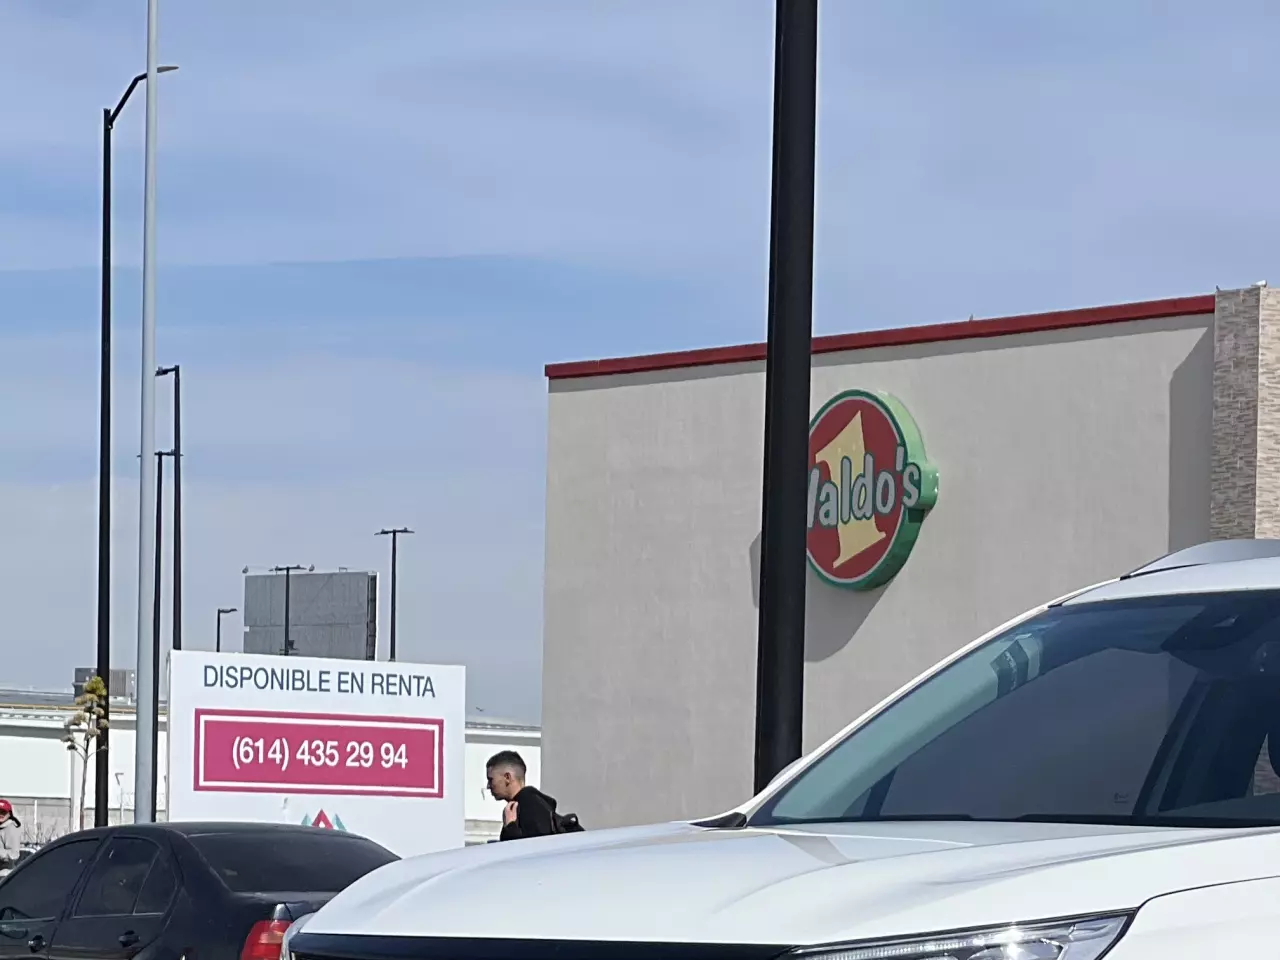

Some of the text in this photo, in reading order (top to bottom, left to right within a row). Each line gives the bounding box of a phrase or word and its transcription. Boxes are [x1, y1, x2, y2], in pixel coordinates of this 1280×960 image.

[203, 665, 436, 698] DISPONIBLE EN RENTA
[232, 736, 408, 771] (614) 435 29 94
